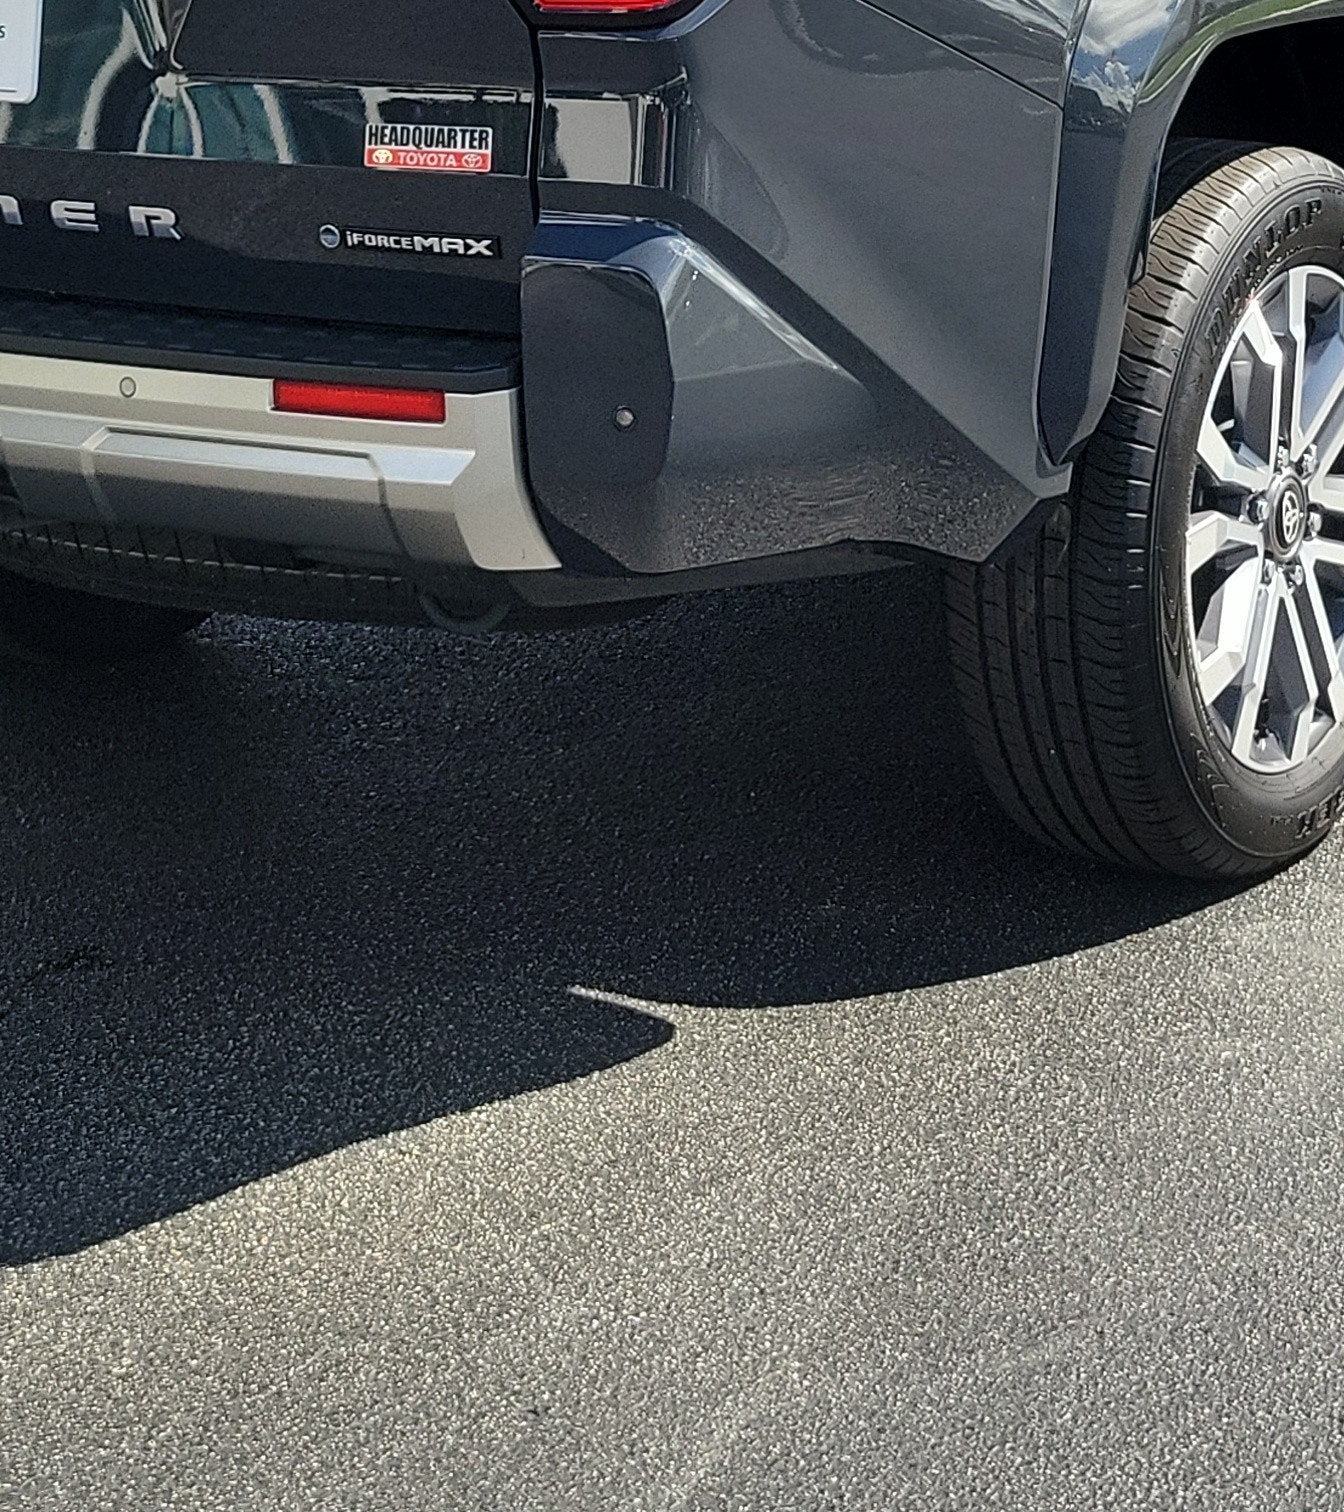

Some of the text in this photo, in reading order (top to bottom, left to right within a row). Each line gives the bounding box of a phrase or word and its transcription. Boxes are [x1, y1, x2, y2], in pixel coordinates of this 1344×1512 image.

[367, 124, 489, 150] HEADQUARTER
[397, 151, 458, 167] TOYOTA
[1206, 197, 1323, 364] DUNLOP
